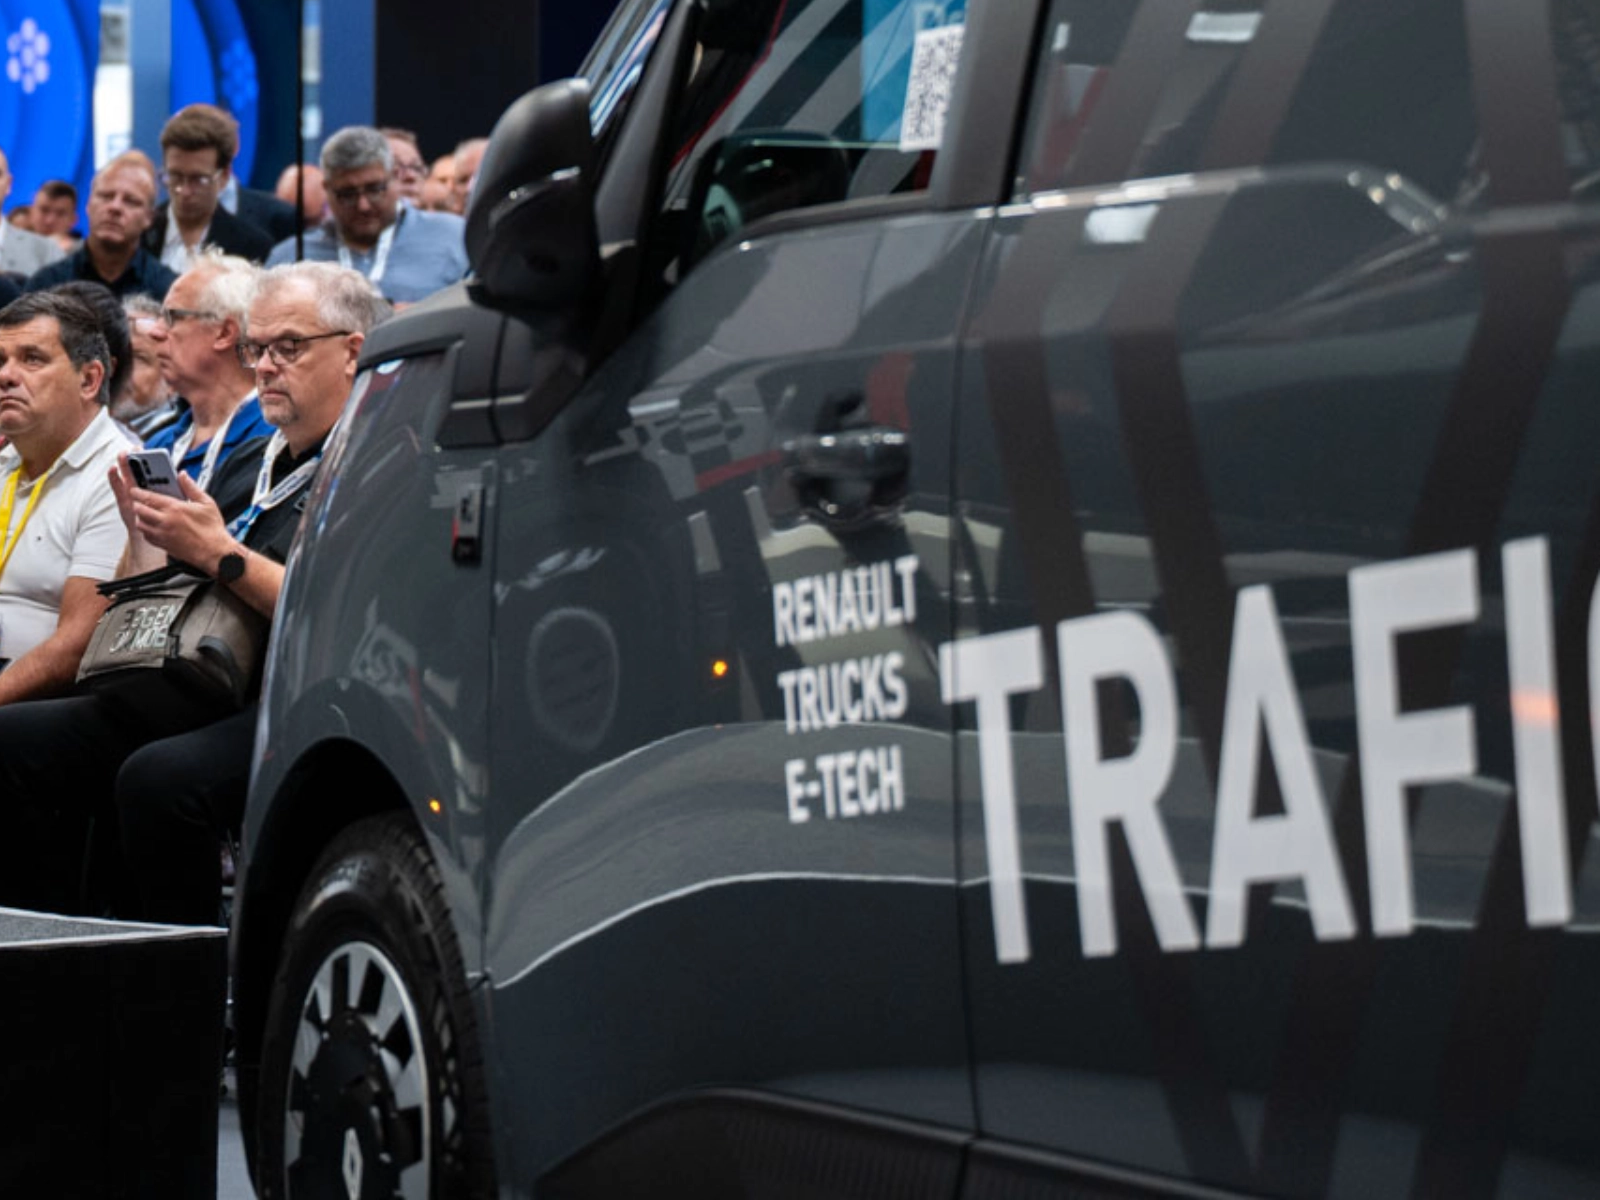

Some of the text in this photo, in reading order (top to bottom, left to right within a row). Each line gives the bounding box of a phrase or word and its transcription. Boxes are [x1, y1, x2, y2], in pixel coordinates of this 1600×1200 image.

[772, 554, 919, 648] RENAULT
[777, 651, 907, 735] TRUCKS
[785, 743, 905, 823] E-TECH
[940, 534, 1600, 963] TRAFI
